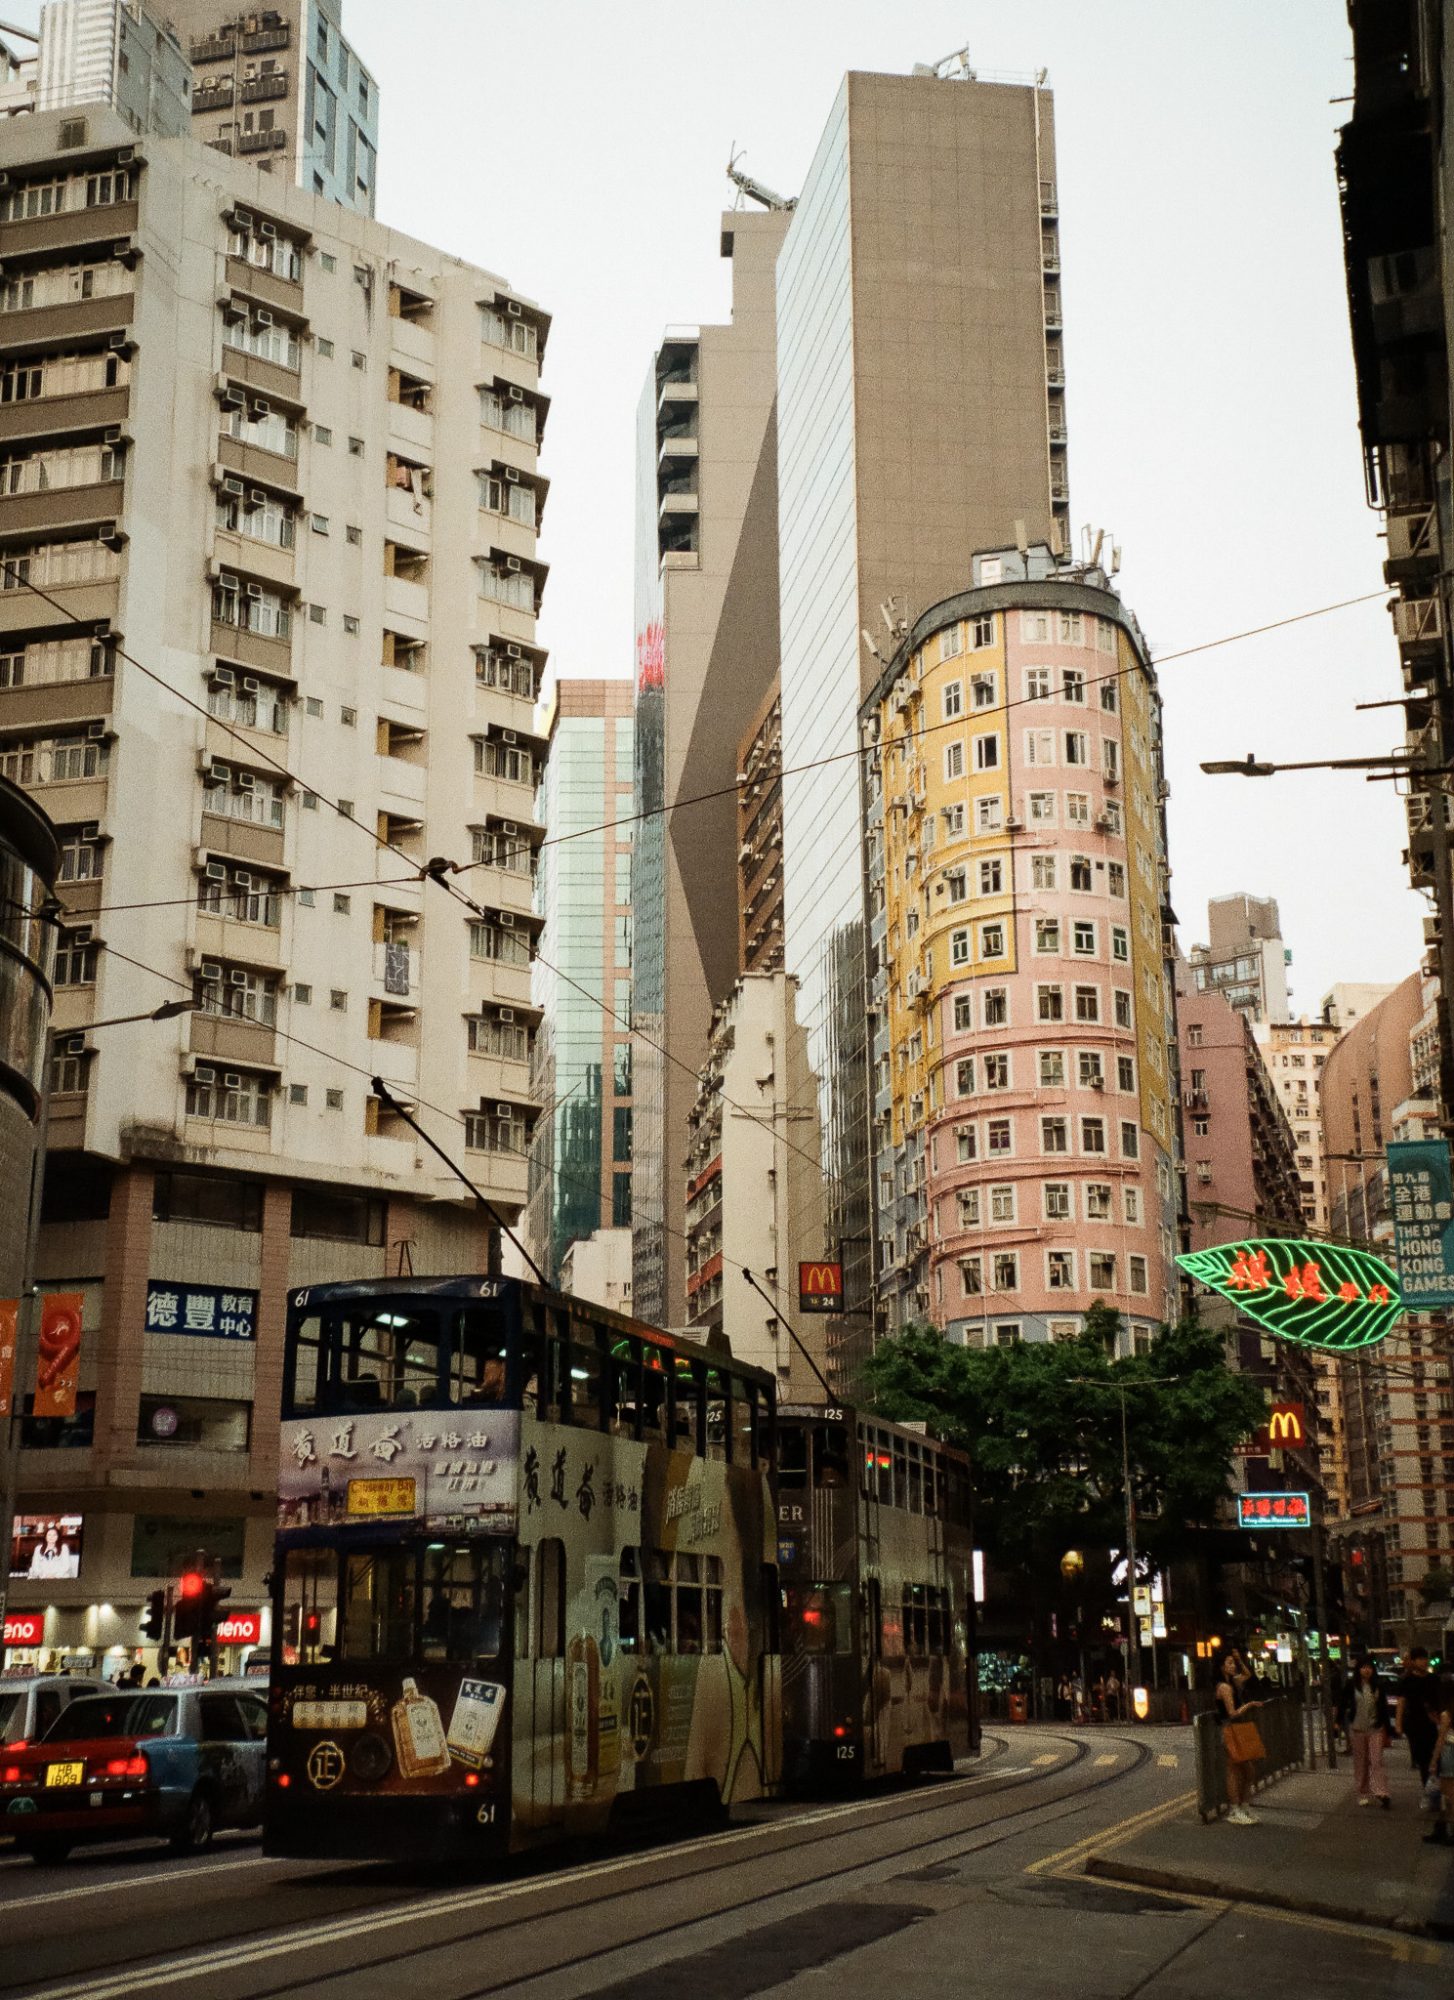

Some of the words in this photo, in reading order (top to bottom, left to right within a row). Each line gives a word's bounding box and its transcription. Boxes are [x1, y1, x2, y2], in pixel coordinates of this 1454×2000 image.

[1395, 1185, 1431, 1201] 全港
[1396, 1201, 1452, 1221] 運動會
[1398, 1225, 1419, 1238] THE
[1400, 1239, 1442, 1256] HONG
[1401, 1257, 1445, 1274] KONG
[480, 1282, 497, 1297] 61
[1402, 1274, 1454, 1293] GAMES
[221, 1293, 253, 1314] 教育
[295, 1290, 309, 1307] 61
[823, 1297, 835, 1307] 24
[220, 1316, 252, 1337] 中心
[824, 1409, 843, 1421] 125
[779, 1505, 803, 1521] ER
[837, 1746, 855, 1760] 125
[58, 1765, 73, 1775] HB
[51, 1774, 78, 1786] 1809
[477, 1804, 495, 1824] 61
